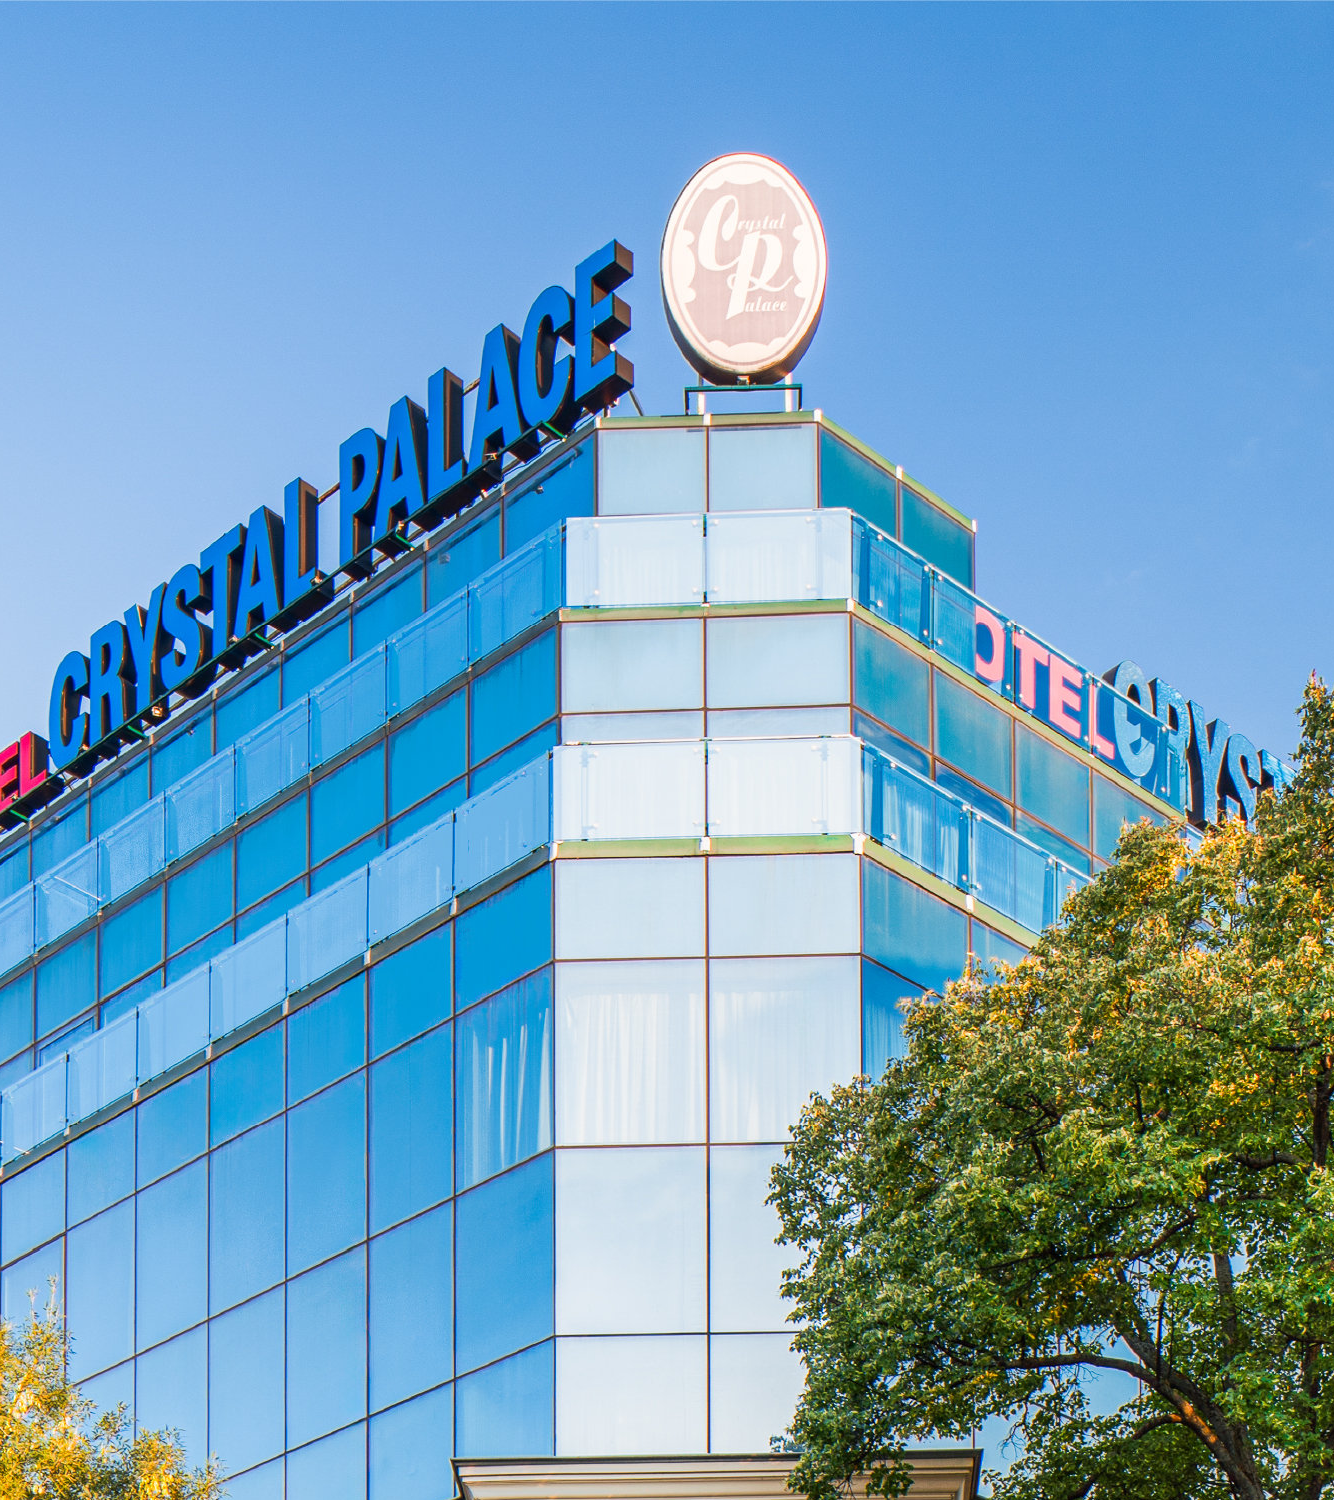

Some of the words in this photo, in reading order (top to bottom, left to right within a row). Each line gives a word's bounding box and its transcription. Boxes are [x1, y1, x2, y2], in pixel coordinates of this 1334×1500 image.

[698, 194, 786, 272] Crystal
[725, 230, 795, 321] Palace
[49, 476, 319, 771] CRYSTAL
[339, 238, 631, 570] PALACE
